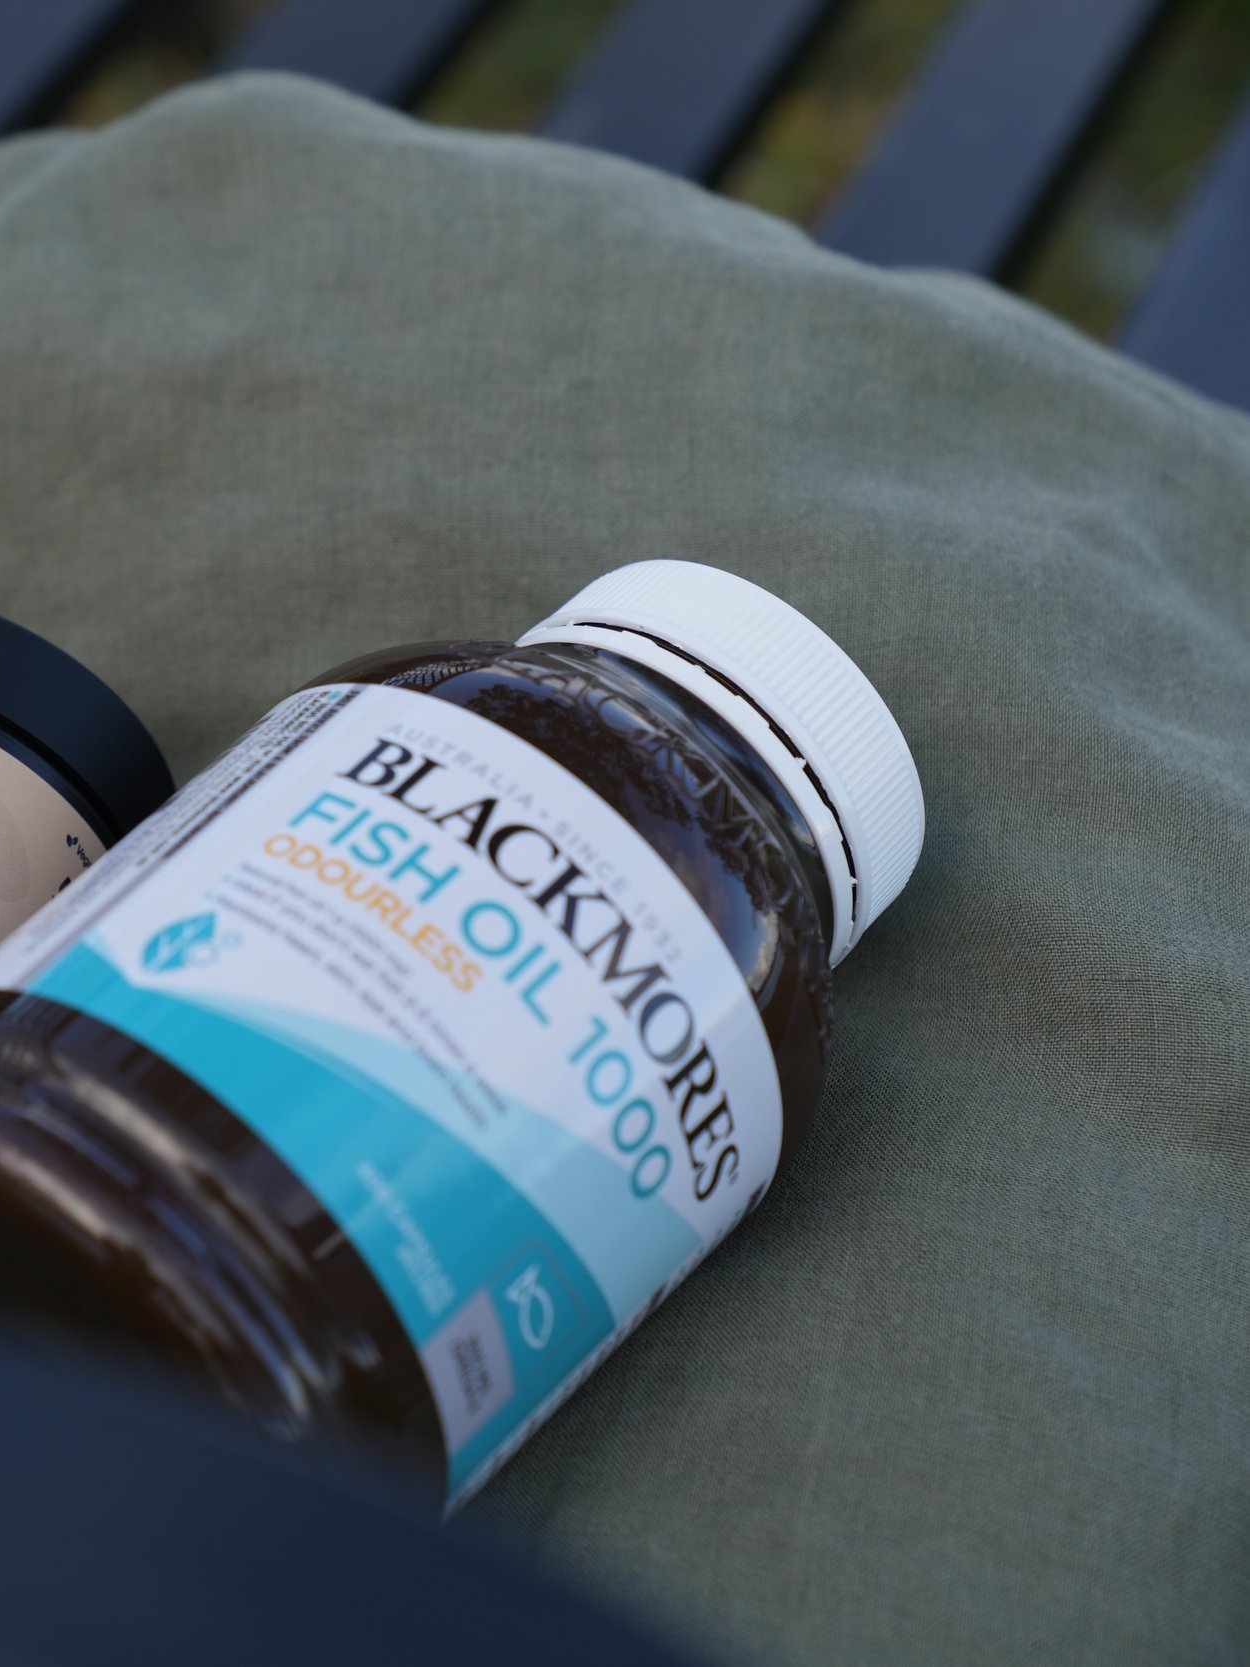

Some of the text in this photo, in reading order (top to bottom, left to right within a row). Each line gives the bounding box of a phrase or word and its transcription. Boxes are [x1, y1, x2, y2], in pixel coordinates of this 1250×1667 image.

[264, 834, 484, 993] ODOURLESS
[386, 723, 682, 962] AUSTRALIA SINCE 1932
[288, 791, 460, 904] FISH
[461, 900, 562, 1026] OIL
[568, 1015, 671, 1200] 1000
